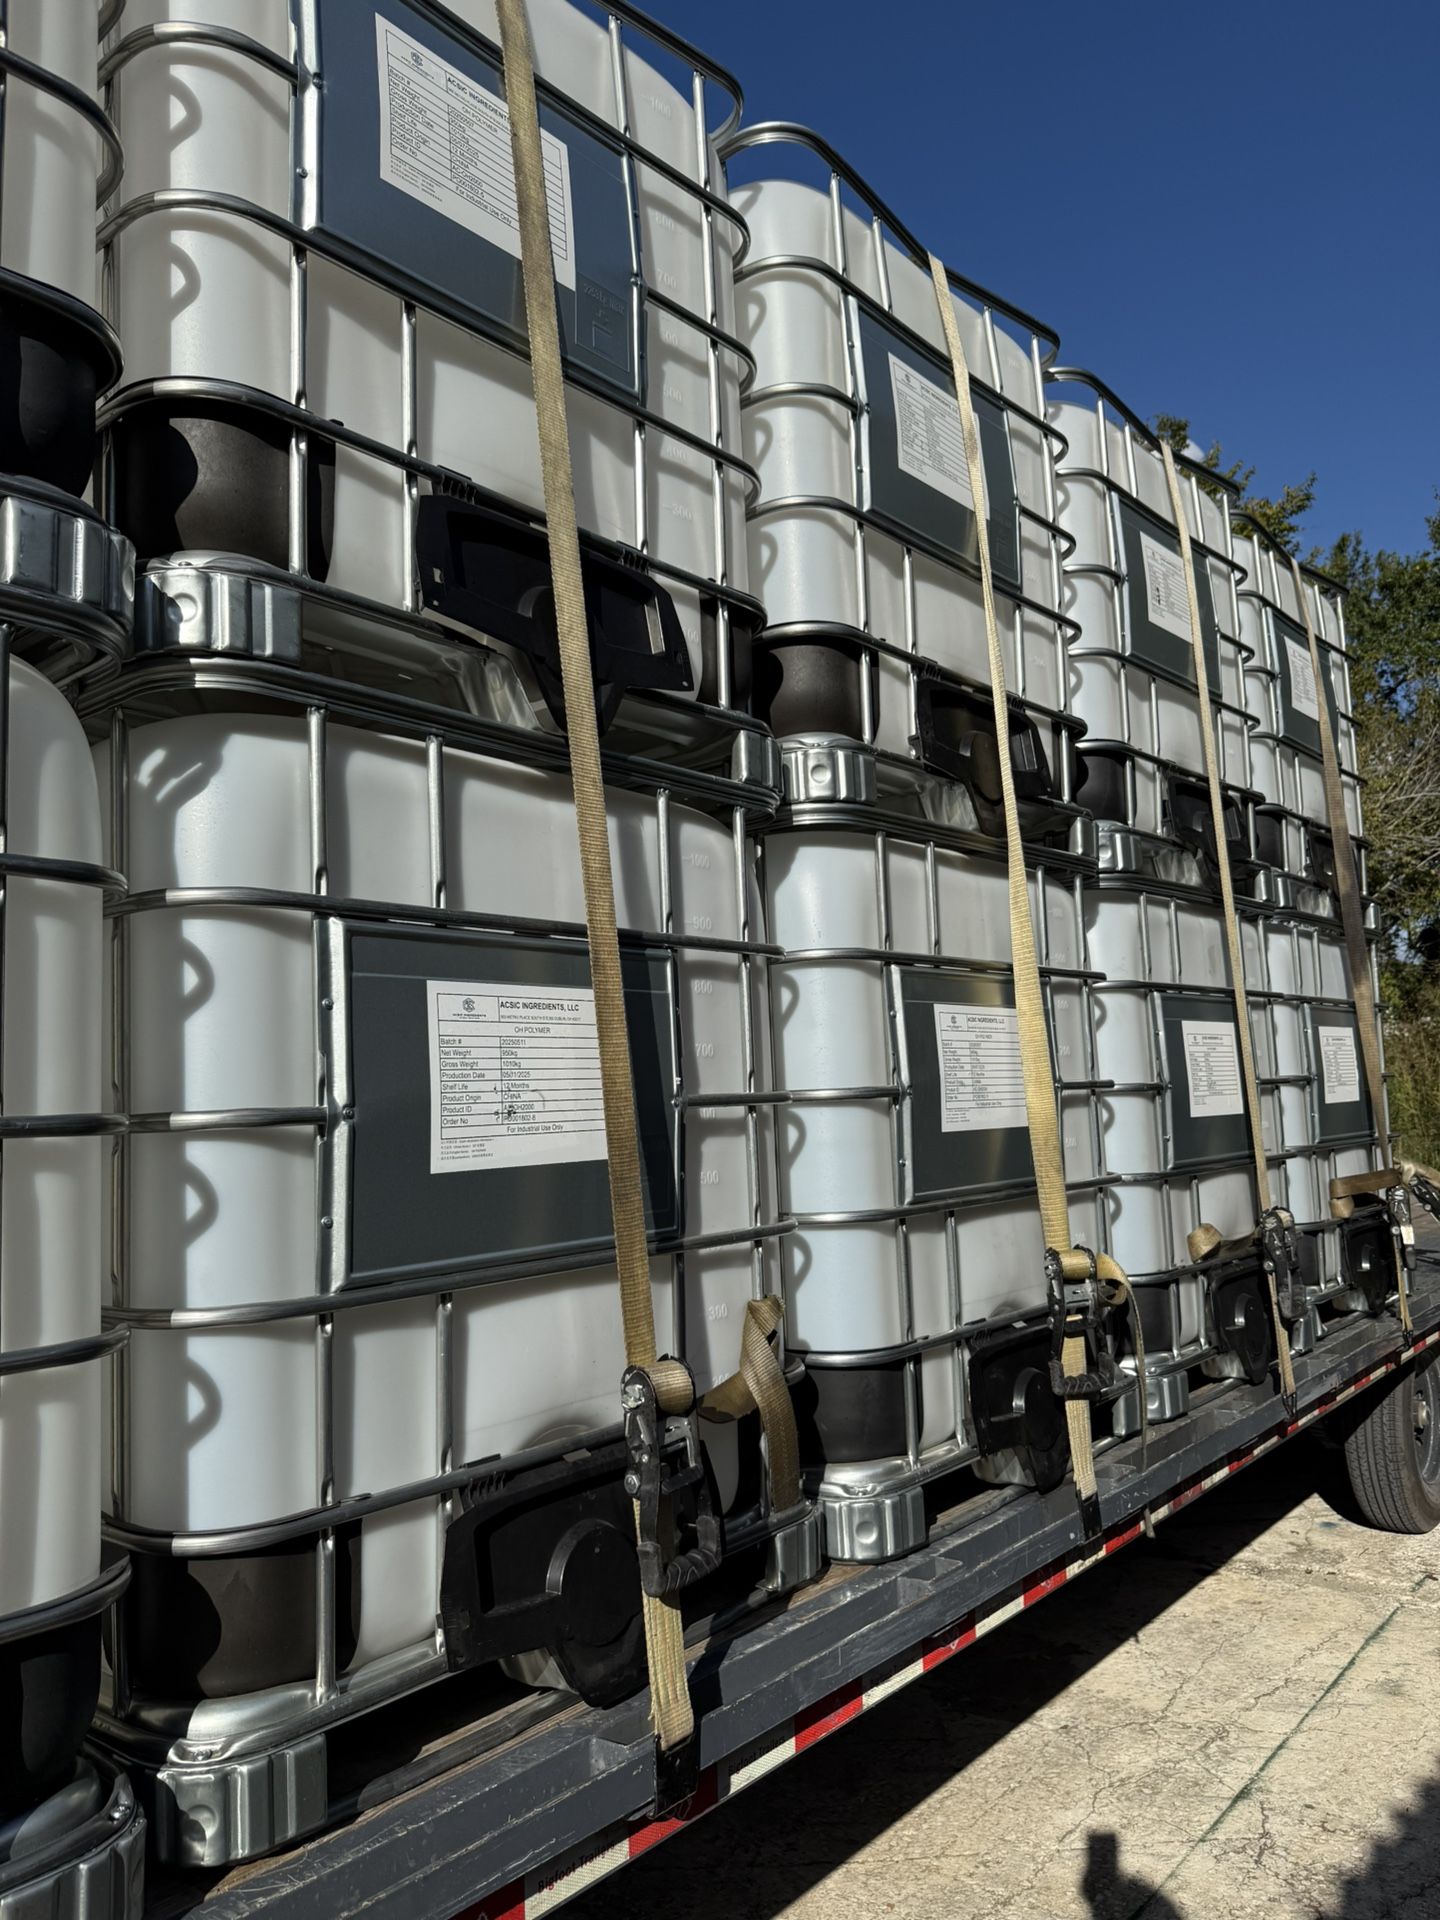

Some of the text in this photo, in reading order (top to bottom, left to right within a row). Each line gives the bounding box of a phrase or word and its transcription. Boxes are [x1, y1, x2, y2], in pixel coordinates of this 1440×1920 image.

[391, 97, 420, 120] Production
[690, 853, 711, 869] 1000
[693, 916, 712, 930] 900
[694, 979, 713, 994] 800
[500, 1001, 520, 1009] ACSIC
[522, 1002, 566, 1012] INGREDIENTS,
[524, 1026, 551, 1034] POLYMER
[452, 1049, 472, 1058] Weight
[695, 1043, 714, 1057] 700
[442, 1060, 458, 1068] Gross
[459, 1060, 478, 1069] Weight
[442, 1083, 457, 1091] Shelf
[442, 1094, 464, 1102] Product
[465, 1094, 481, 1102] Origin
[442, 1106, 464, 1114] Product
[442, 1117, 458, 1125] Order
[552, 1123, 563, 1132] Only
[701, 1170, 719, 1184] 500
[708, 1303, 728, 1320] 300
[537, 1839, 616, 1893] Bigfoot Trailers
